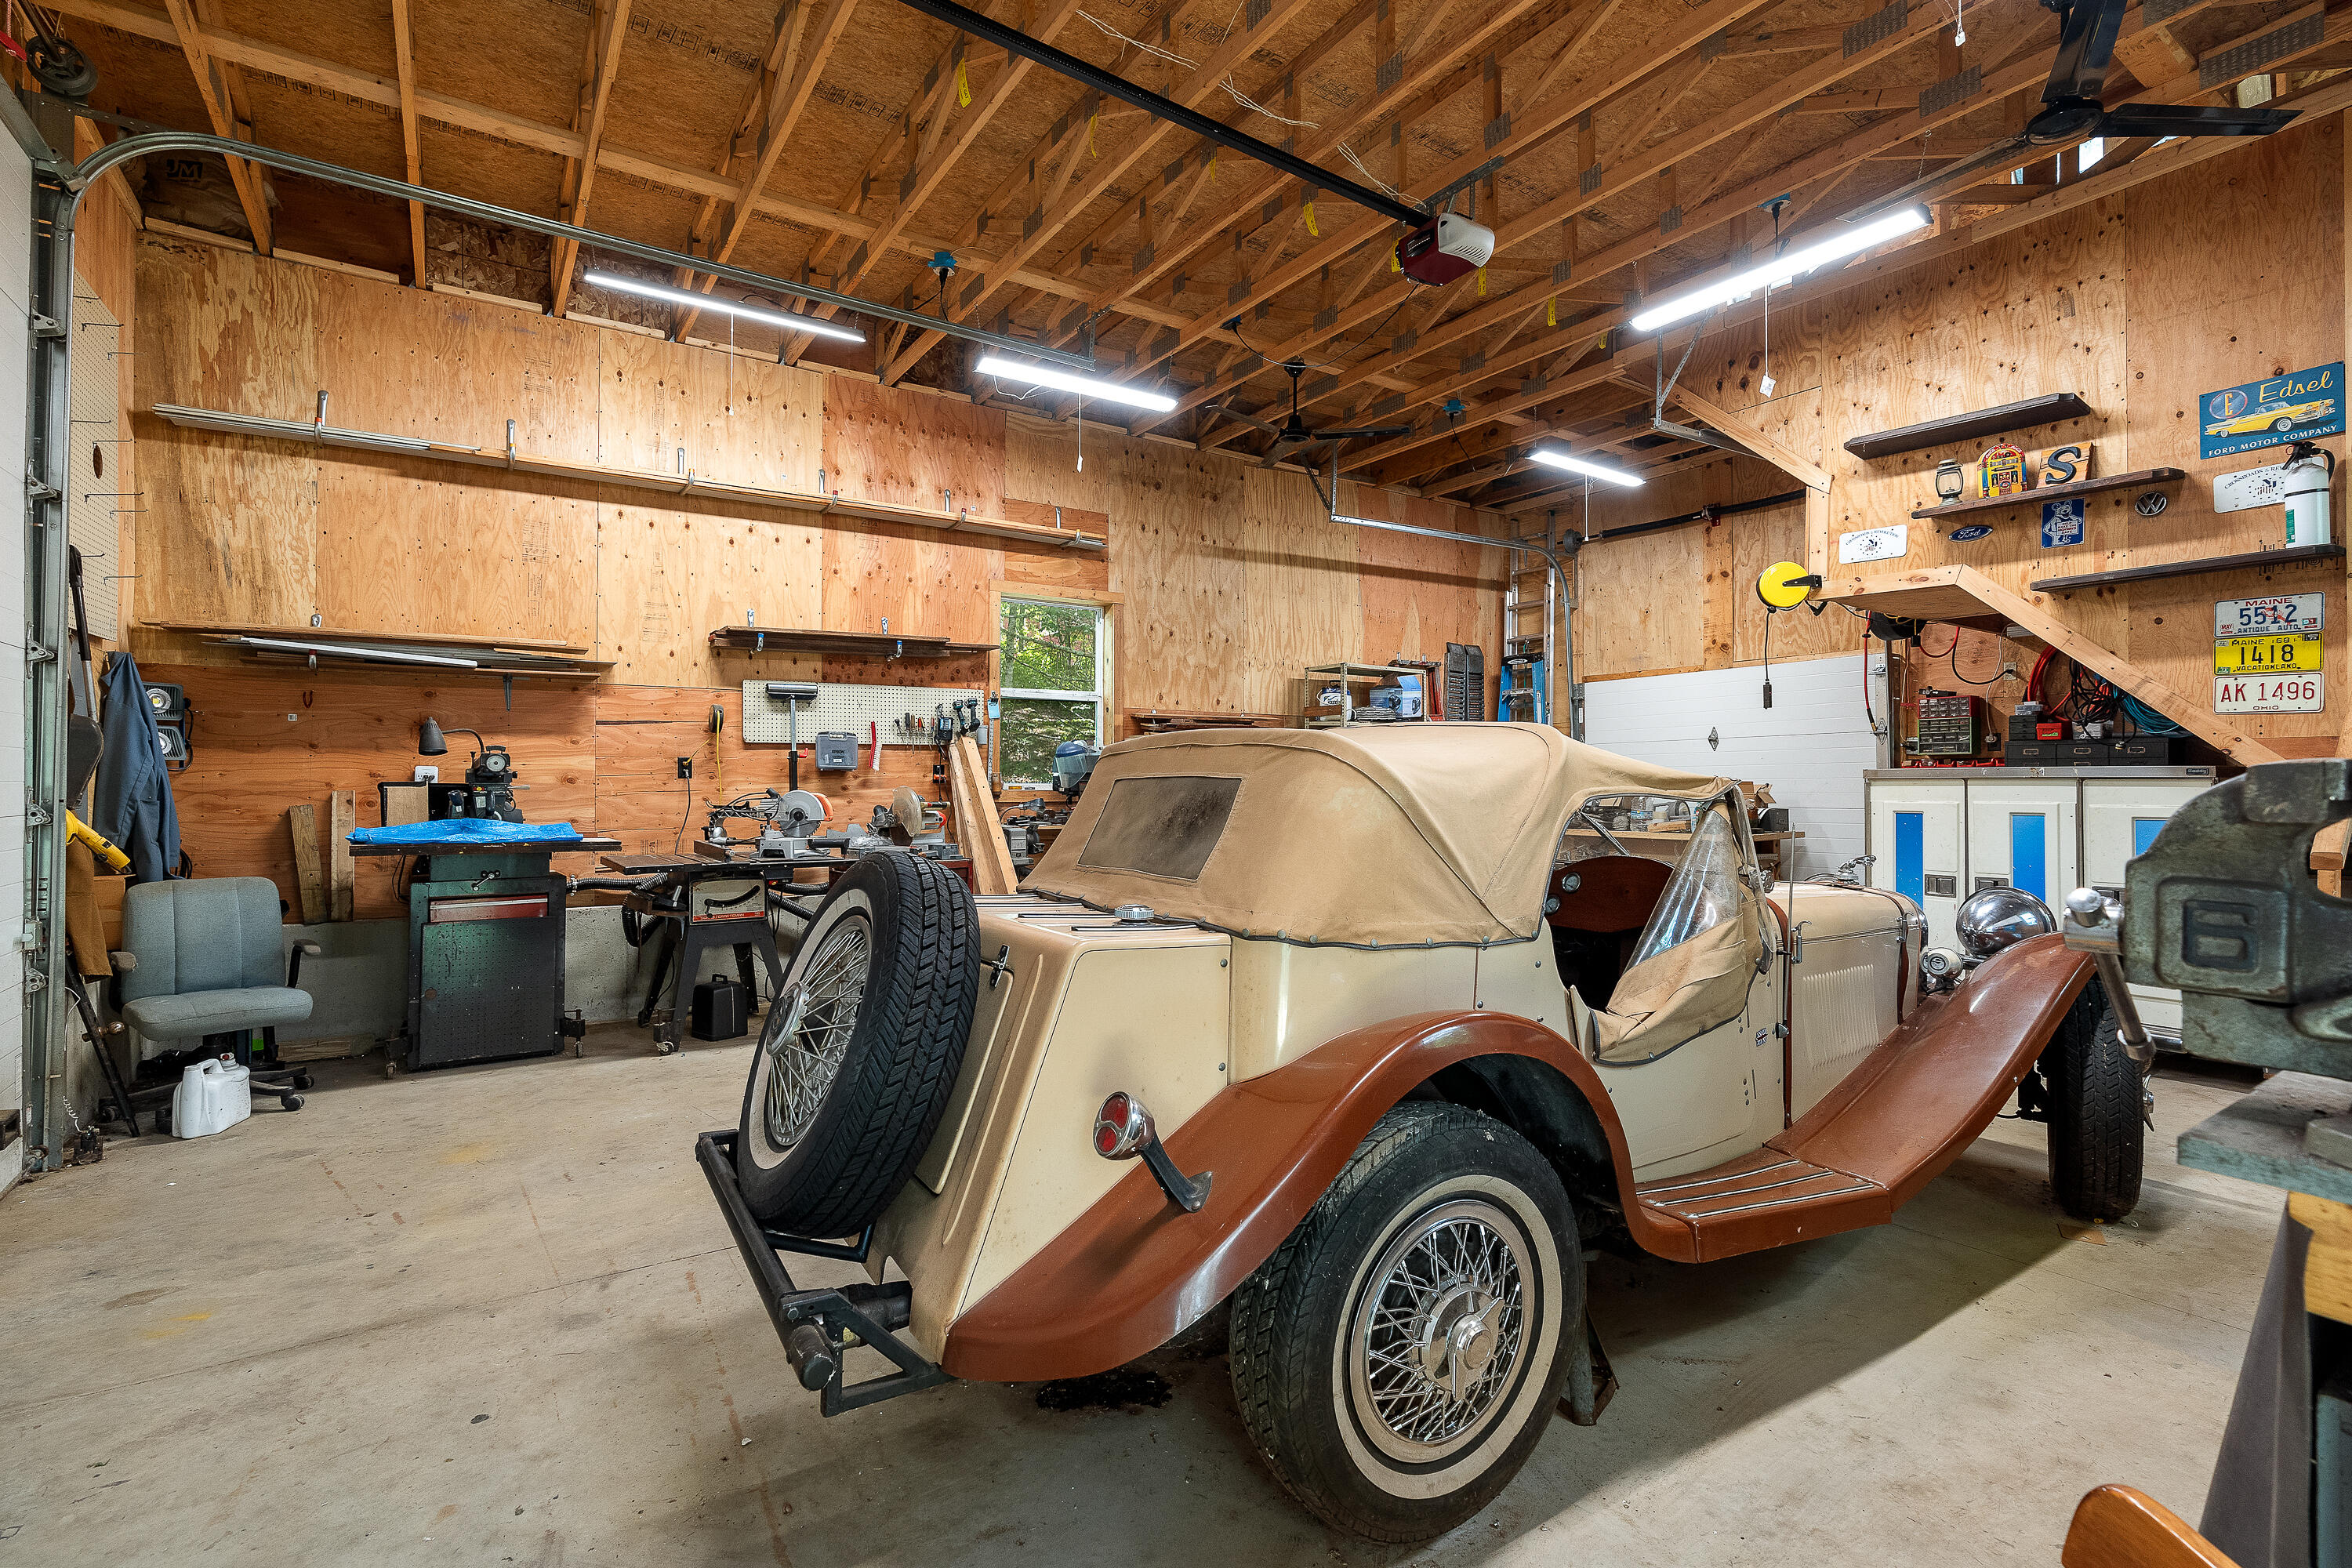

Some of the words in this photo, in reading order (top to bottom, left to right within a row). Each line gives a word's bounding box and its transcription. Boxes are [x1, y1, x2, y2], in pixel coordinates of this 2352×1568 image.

[2259, 370, 2334, 403] Edsel
[2224, 394, 2233, 416] E
[2209, 445, 2235, 456] FORD
[2240, 437, 2278, 450] MOTOR
[2283, 424, 2337, 441] COMPANY
[2045, 446, 2082, 485] S
[1958, 528, 1981, 539] Ford
[2245, 597, 2292, 607] MAINE
[2239, 604, 2297, 626] 5512
[2241, 644, 2294, 666] 1418
[2236, 662, 2297, 671] VACATIONLAND
[2220, 684, 2247, 702] AK
[2258, 681, 2315, 701] 1496
[2182, 899, 2258, 972] 6
